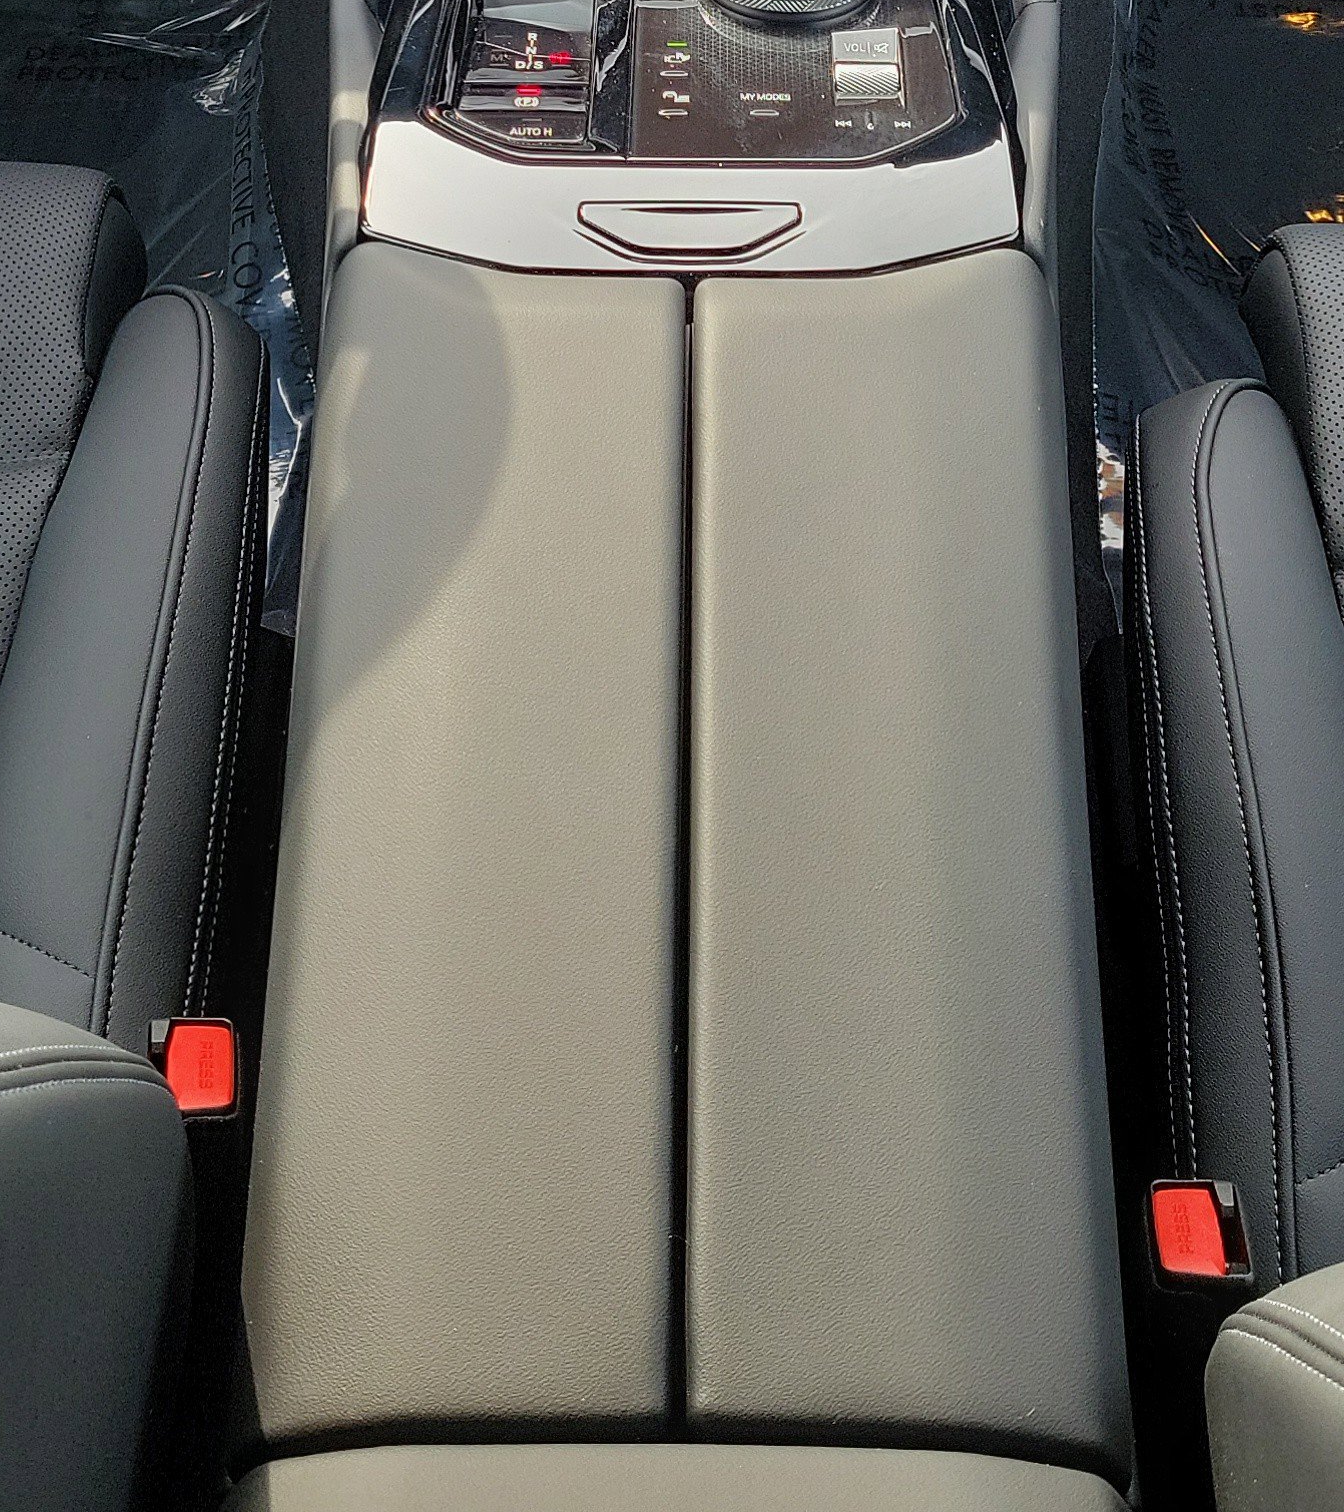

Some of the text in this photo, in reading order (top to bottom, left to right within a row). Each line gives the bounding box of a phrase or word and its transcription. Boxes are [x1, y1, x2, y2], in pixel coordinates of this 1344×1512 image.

[527, 32, 538, 41] R
[526, 46, 537, 55] N
[844, 42, 865, 52] VOL
[740, 93, 755, 101] MY
[510, 127, 553, 136] AUTO H
